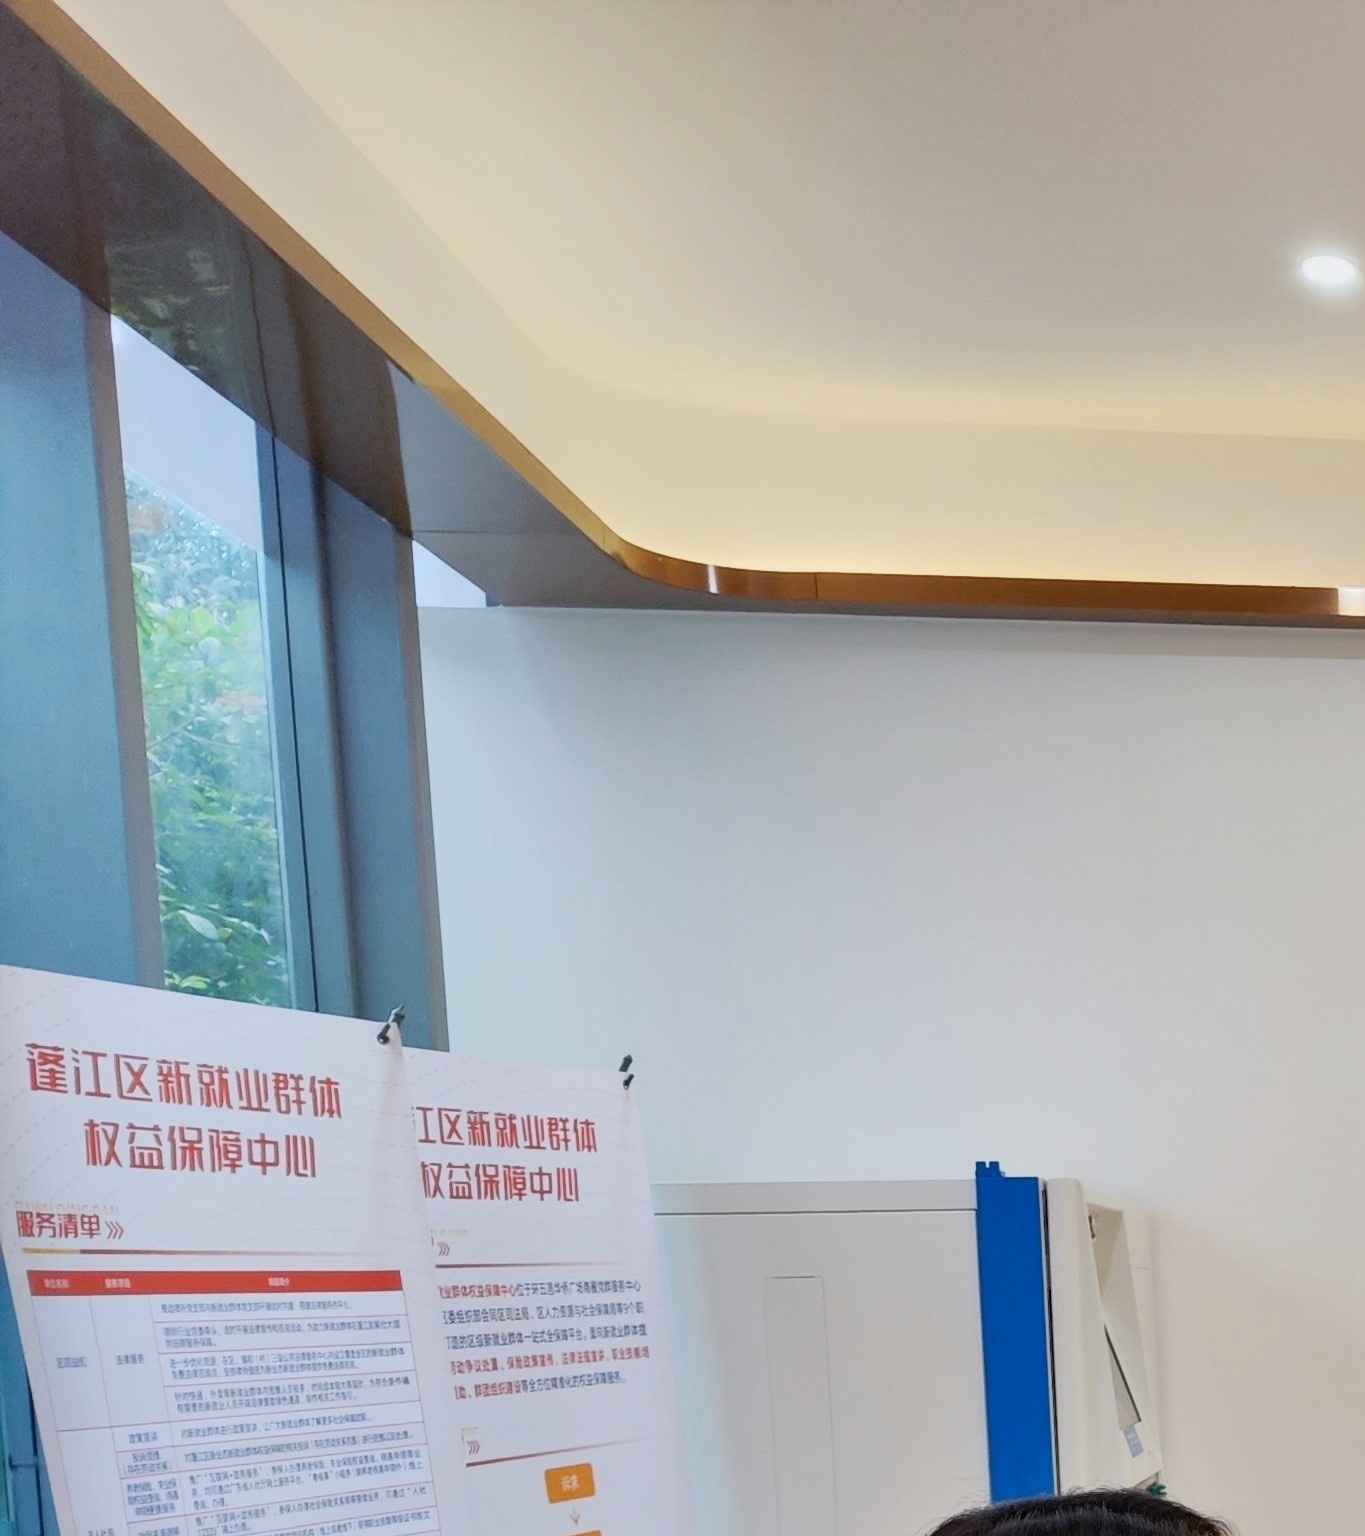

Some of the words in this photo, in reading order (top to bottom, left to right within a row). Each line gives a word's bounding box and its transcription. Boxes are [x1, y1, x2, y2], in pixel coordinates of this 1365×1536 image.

[25, 1043, 342, 1119] 蓬江区新就业群体
[84, 1119, 316, 1178] 权益保障中心
[421, 1161, 580, 1202] 权益保障中心
[16, 1211, 101, 1239] 服务清单
